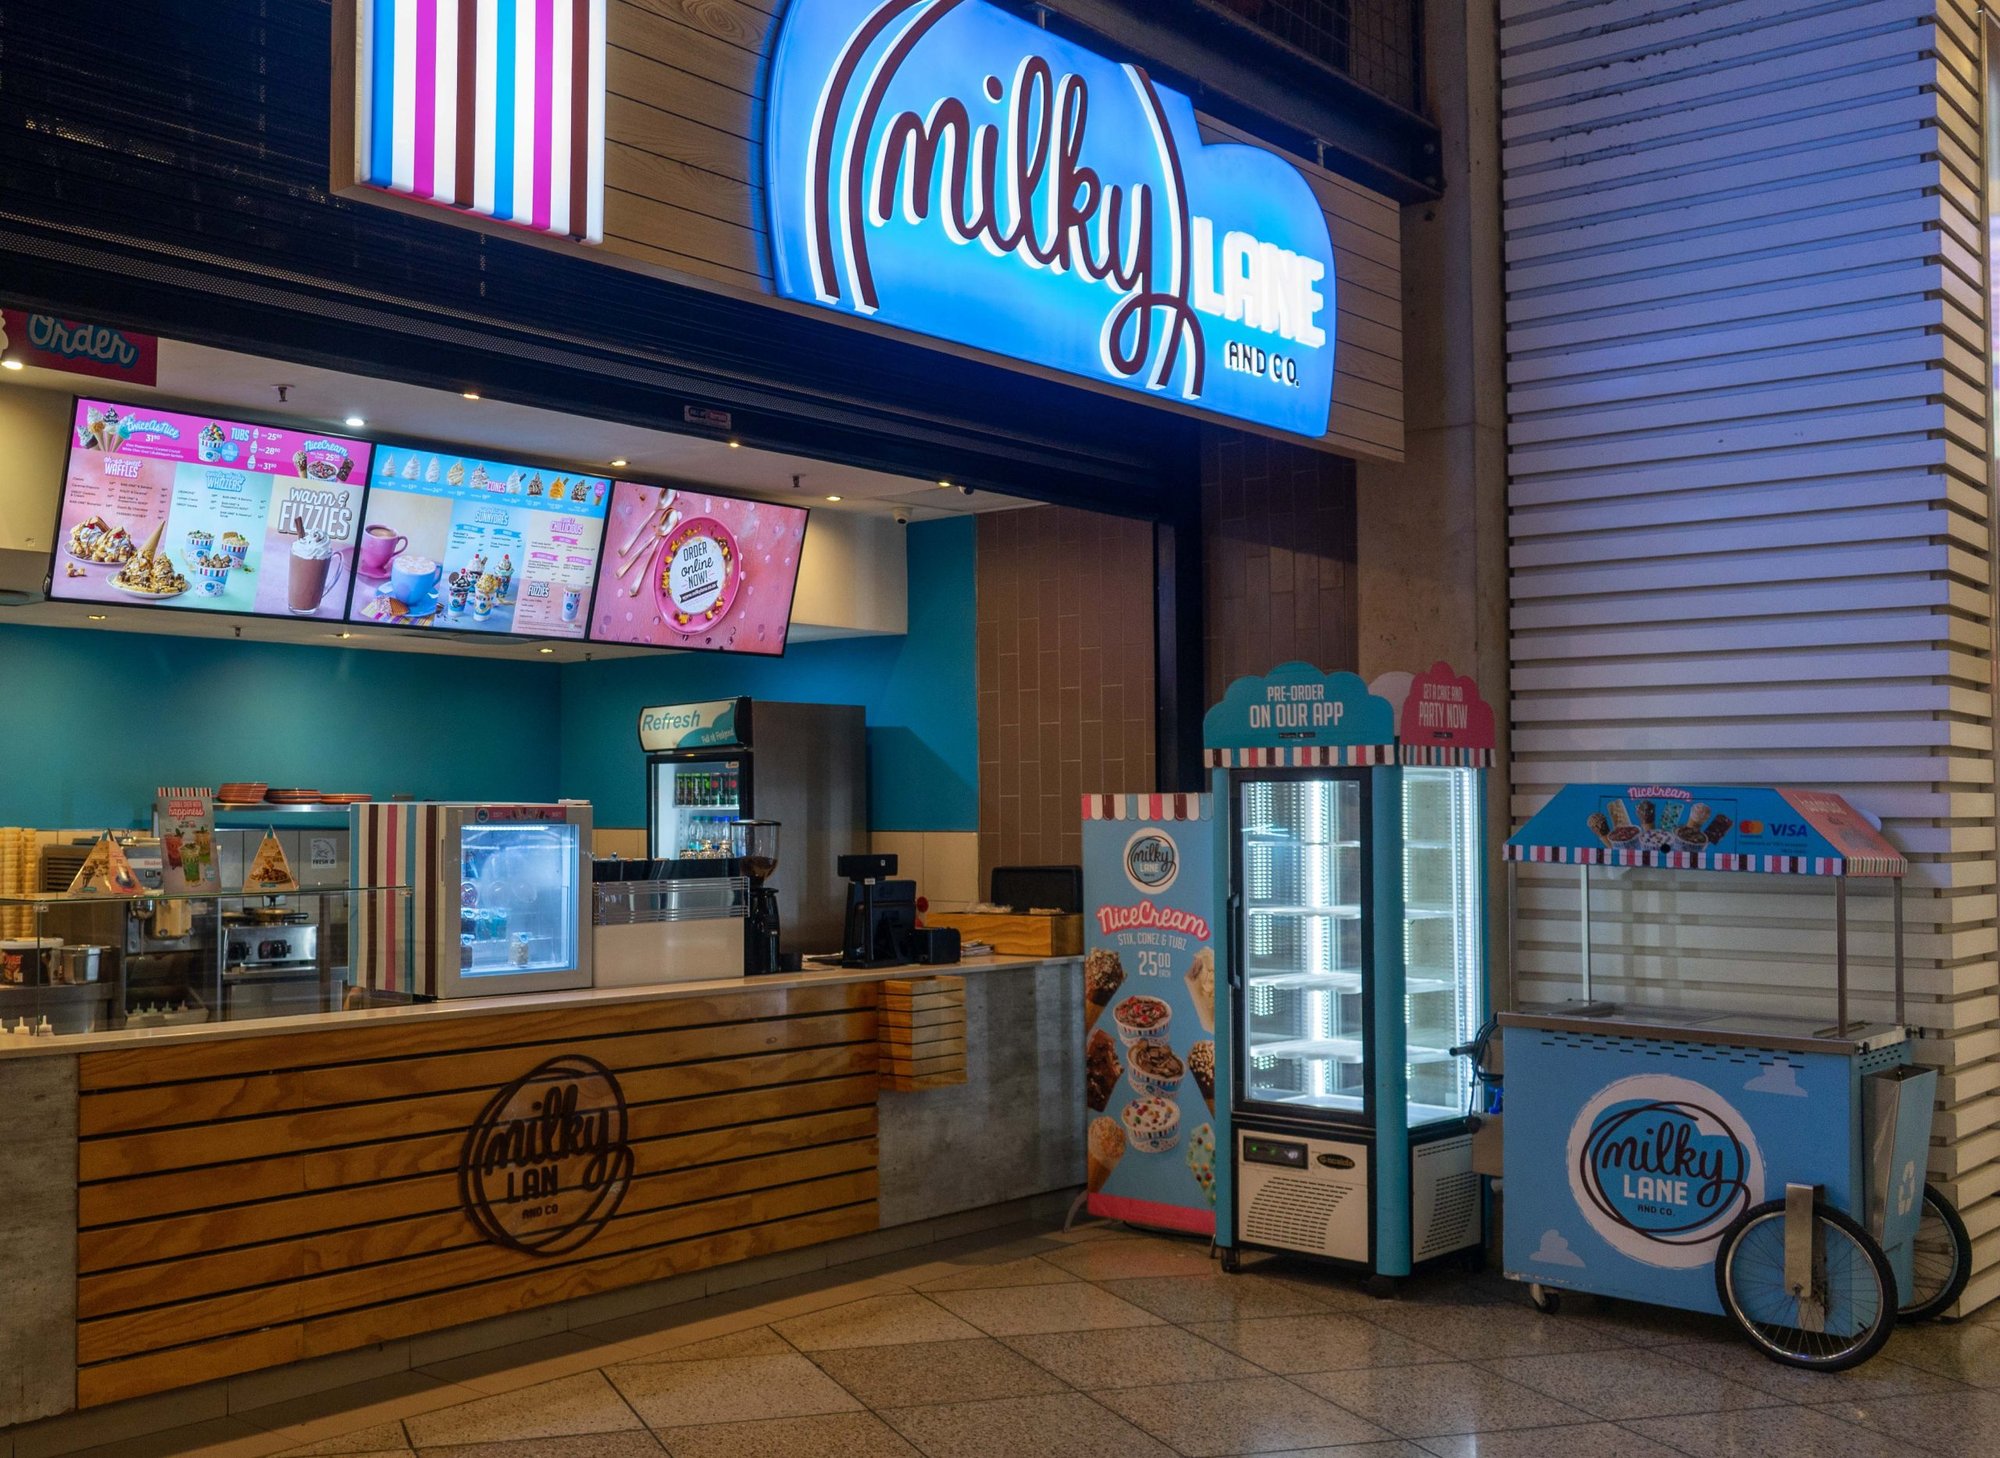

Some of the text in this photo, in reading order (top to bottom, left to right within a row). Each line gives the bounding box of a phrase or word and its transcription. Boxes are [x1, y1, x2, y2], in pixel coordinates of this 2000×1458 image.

[870, 55, 1153, 377] milky
[1193, 216, 1326, 348] LANE
[29, 314, 136, 364] Order
[1225, 341, 1300, 386] AND CO.
[231, 427, 250, 442] TUBS
[104, 463, 139, 478] WAFFLES
[207, 475, 244, 491] WHIZZERS
[487, 480, 507, 493] CONES
[290, 487, 350, 508] warm &
[279, 500, 352, 539] FUZZIES
[683, 541, 708, 562] ORDER
[681, 557, 714, 577] online
[688, 570, 708, 589] NOW!
[1267, 684, 1325, 702] PRE-ORDER
[642, 710, 701, 732] Refresh
[1250, 702, 1344, 728] ON OUR APP
[1419, 702, 1468, 728] PARTY NOW
[1628, 784, 1692, 802] NiceCream
[168, 807, 204, 820] happiness
[1769, 823, 1808, 837] VISA
[1133, 842, 1170, 872] milky
[1098, 900, 1208, 938] NiceCream
[1138, 932, 1160, 945] CONEZ
[1169, 936, 1188, 951] TUBZ
[485, 1084, 608, 1191] milky
[1602, 1121, 1723, 1207] milky
[1623, 1174, 1688, 1206] LANE
[522, 1203, 559, 1219] AND CO
[1637, 1204, 1657, 1214] AND
